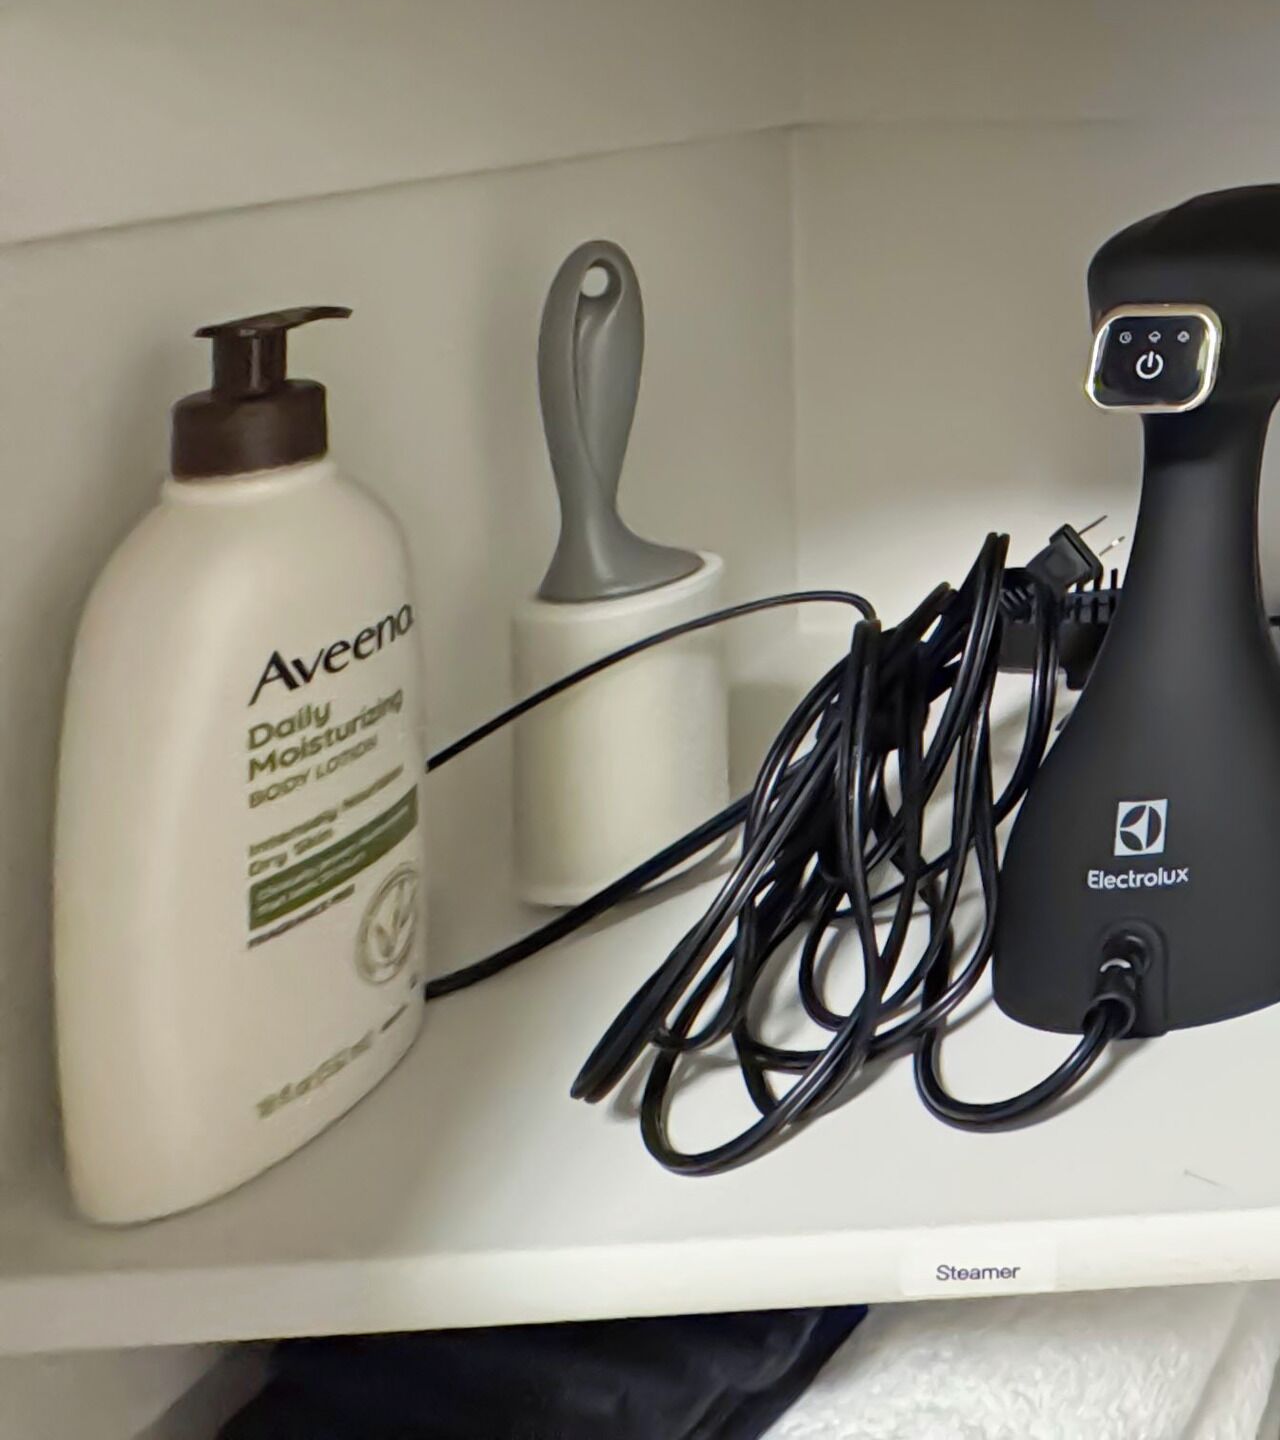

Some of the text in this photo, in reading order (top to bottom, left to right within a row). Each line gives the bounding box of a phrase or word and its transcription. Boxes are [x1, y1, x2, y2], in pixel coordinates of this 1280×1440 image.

[248, 603, 414, 708] Aveeno
[248, 701, 331, 752] Daily
[248, 688, 404, 784] Moisturizing
[249, 734, 378, 810] BODY LOTION
[1086, 867, 1189, 890] Electrolux
[936, 1264, 1021, 1281] Steamer
